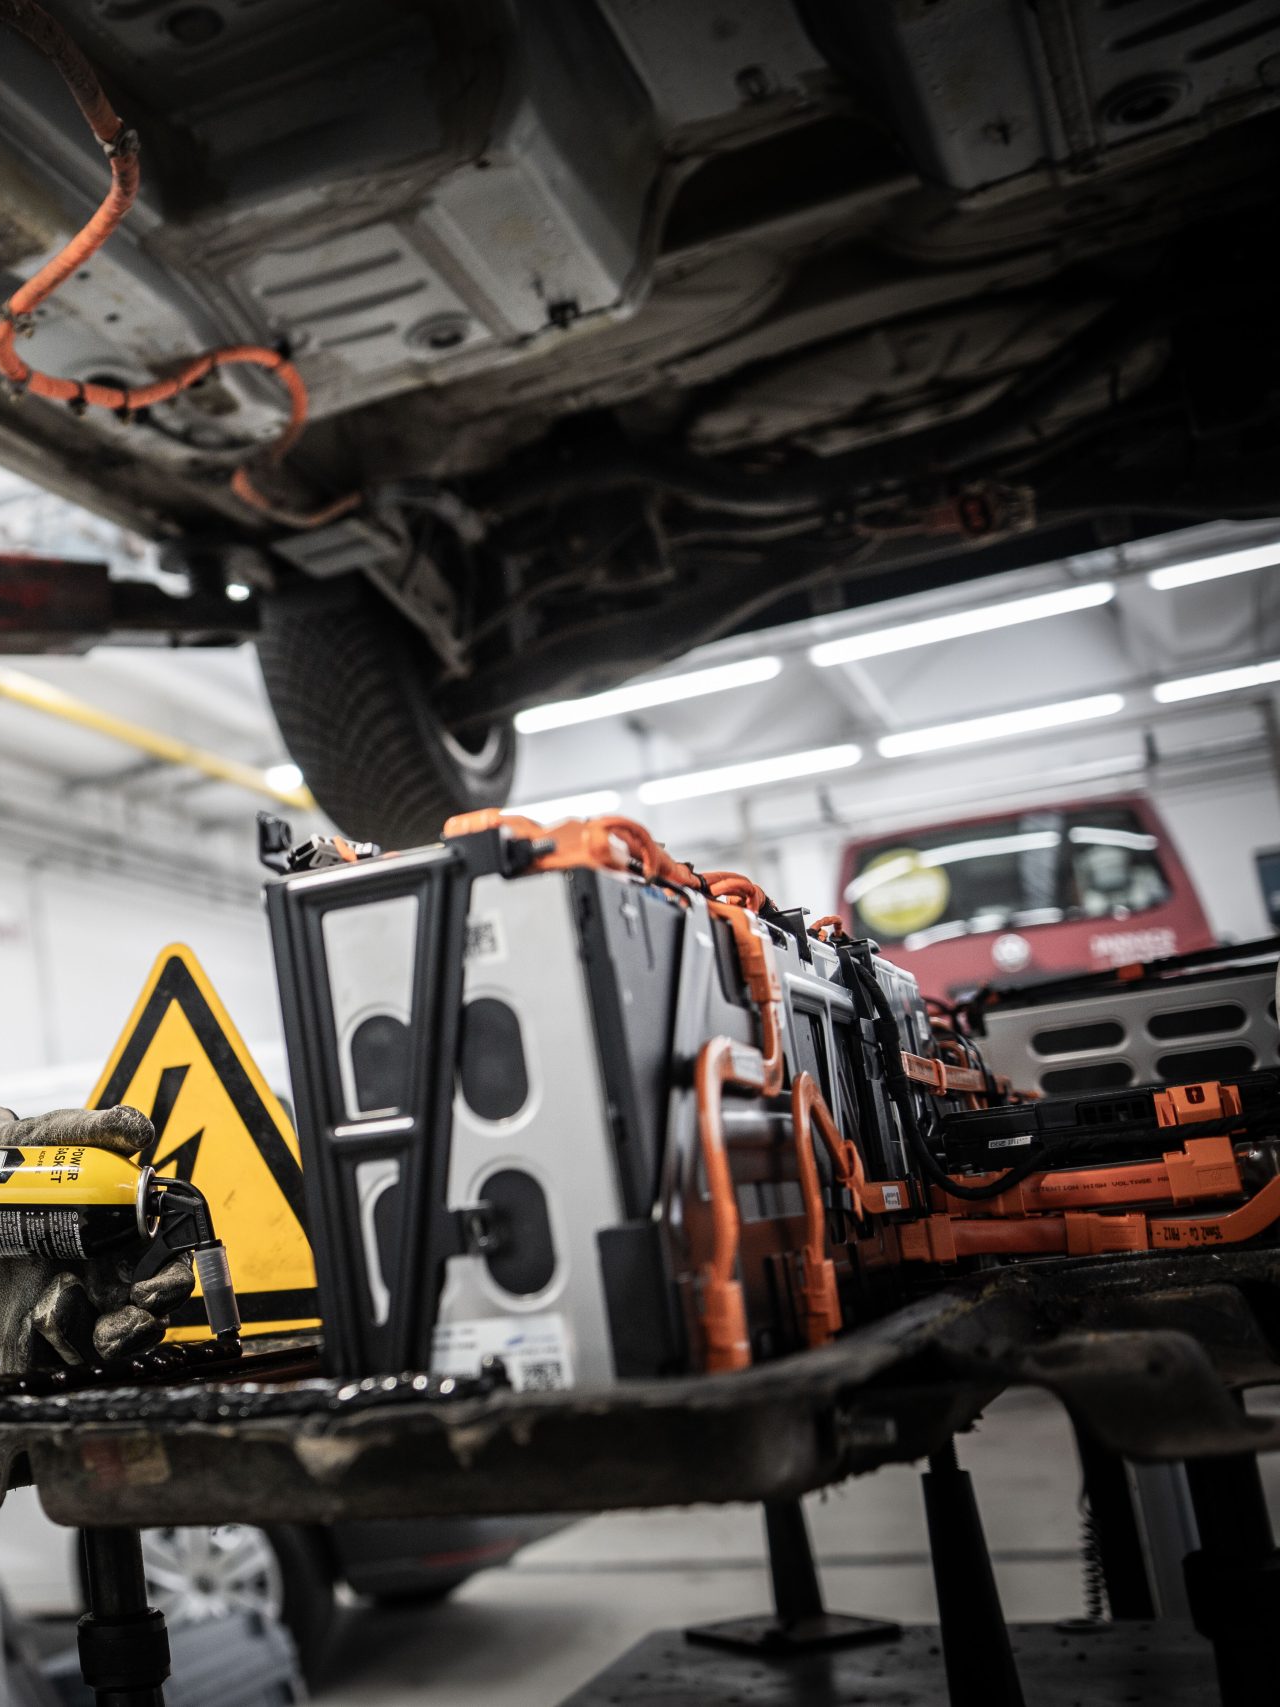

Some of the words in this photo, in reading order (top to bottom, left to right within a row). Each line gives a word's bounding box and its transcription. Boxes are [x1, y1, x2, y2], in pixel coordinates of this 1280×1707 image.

[50, 1148, 69, 1183] GASKET
[67, 1148, 85, 1181] POWER
[1082, 1182, 1107, 1190] HIGH
[1111, 1178, 1152, 1188] VOLTAGE
